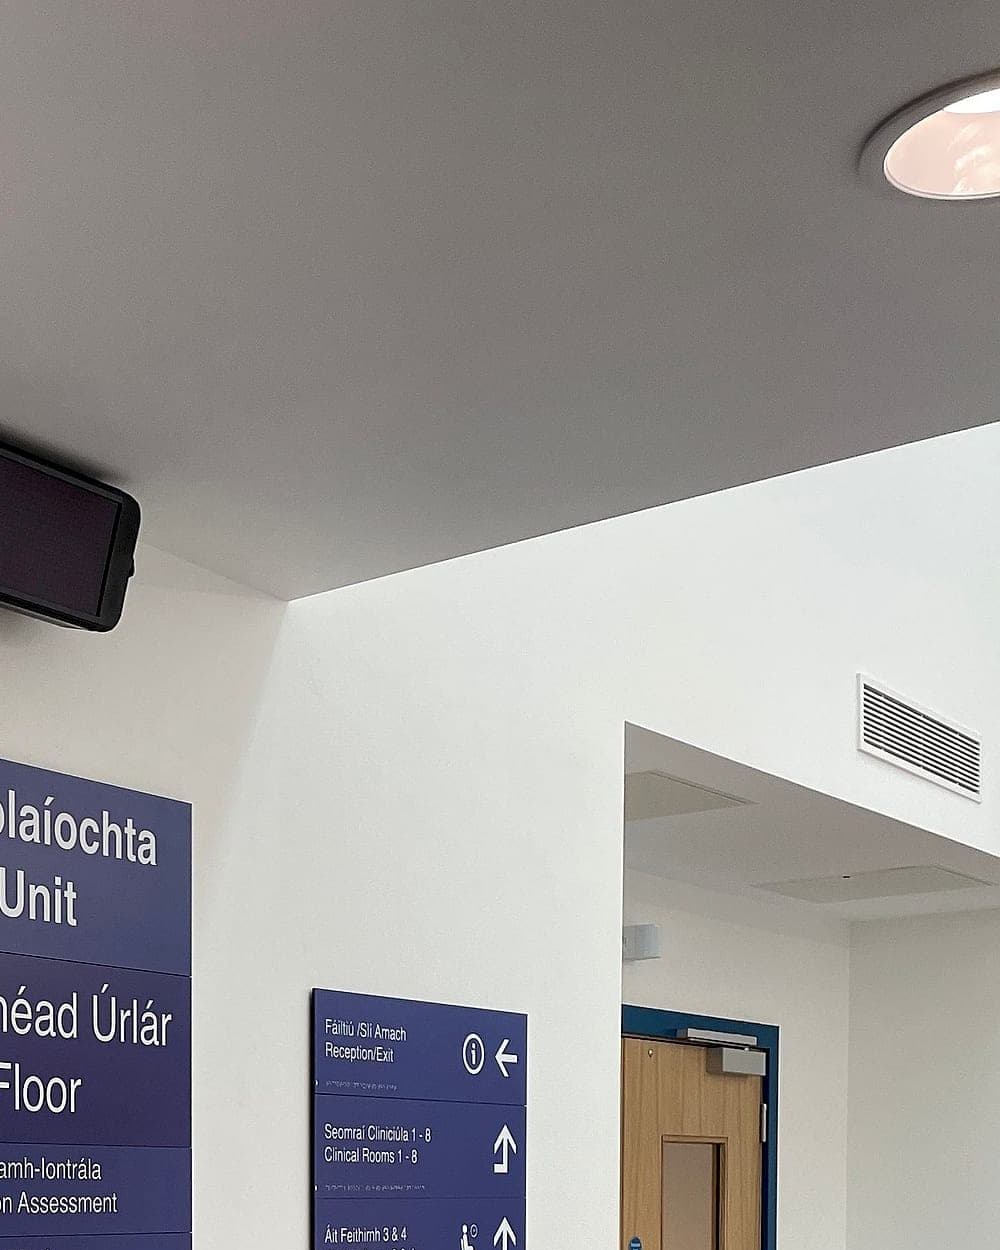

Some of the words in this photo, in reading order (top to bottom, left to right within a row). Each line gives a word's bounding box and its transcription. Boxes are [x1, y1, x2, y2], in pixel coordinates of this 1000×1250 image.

[92, 983, 173, 1047] Úrlár
[325, 1018, 355, 1037] Fáiltiú
[373, 1023, 407, 1042] Amach
[325, 1041, 394, 1063] Reception/Exit
[324, 1123, 366, 1140] Seomraí
[411, 1127, 416, 1142] 1
[424, 1127, 432, 1143] 8
[324, 1146, 360, 1163] Clinical
[362, 1147, 395, 1164] Rooms
[397, 1148, 402, 1163] 1
[411, 1149, 418, 1164] 8
[17, 1191, 118, 1214] Assessment
[324, 1224, 338, 1244] Áit
[340, 1226, 381, 1243] Feithimh
[382, 1227, 390, 1242] 3
[391, 1226, 399, 1242] &
[400, 1226, 407, 1241] 4
